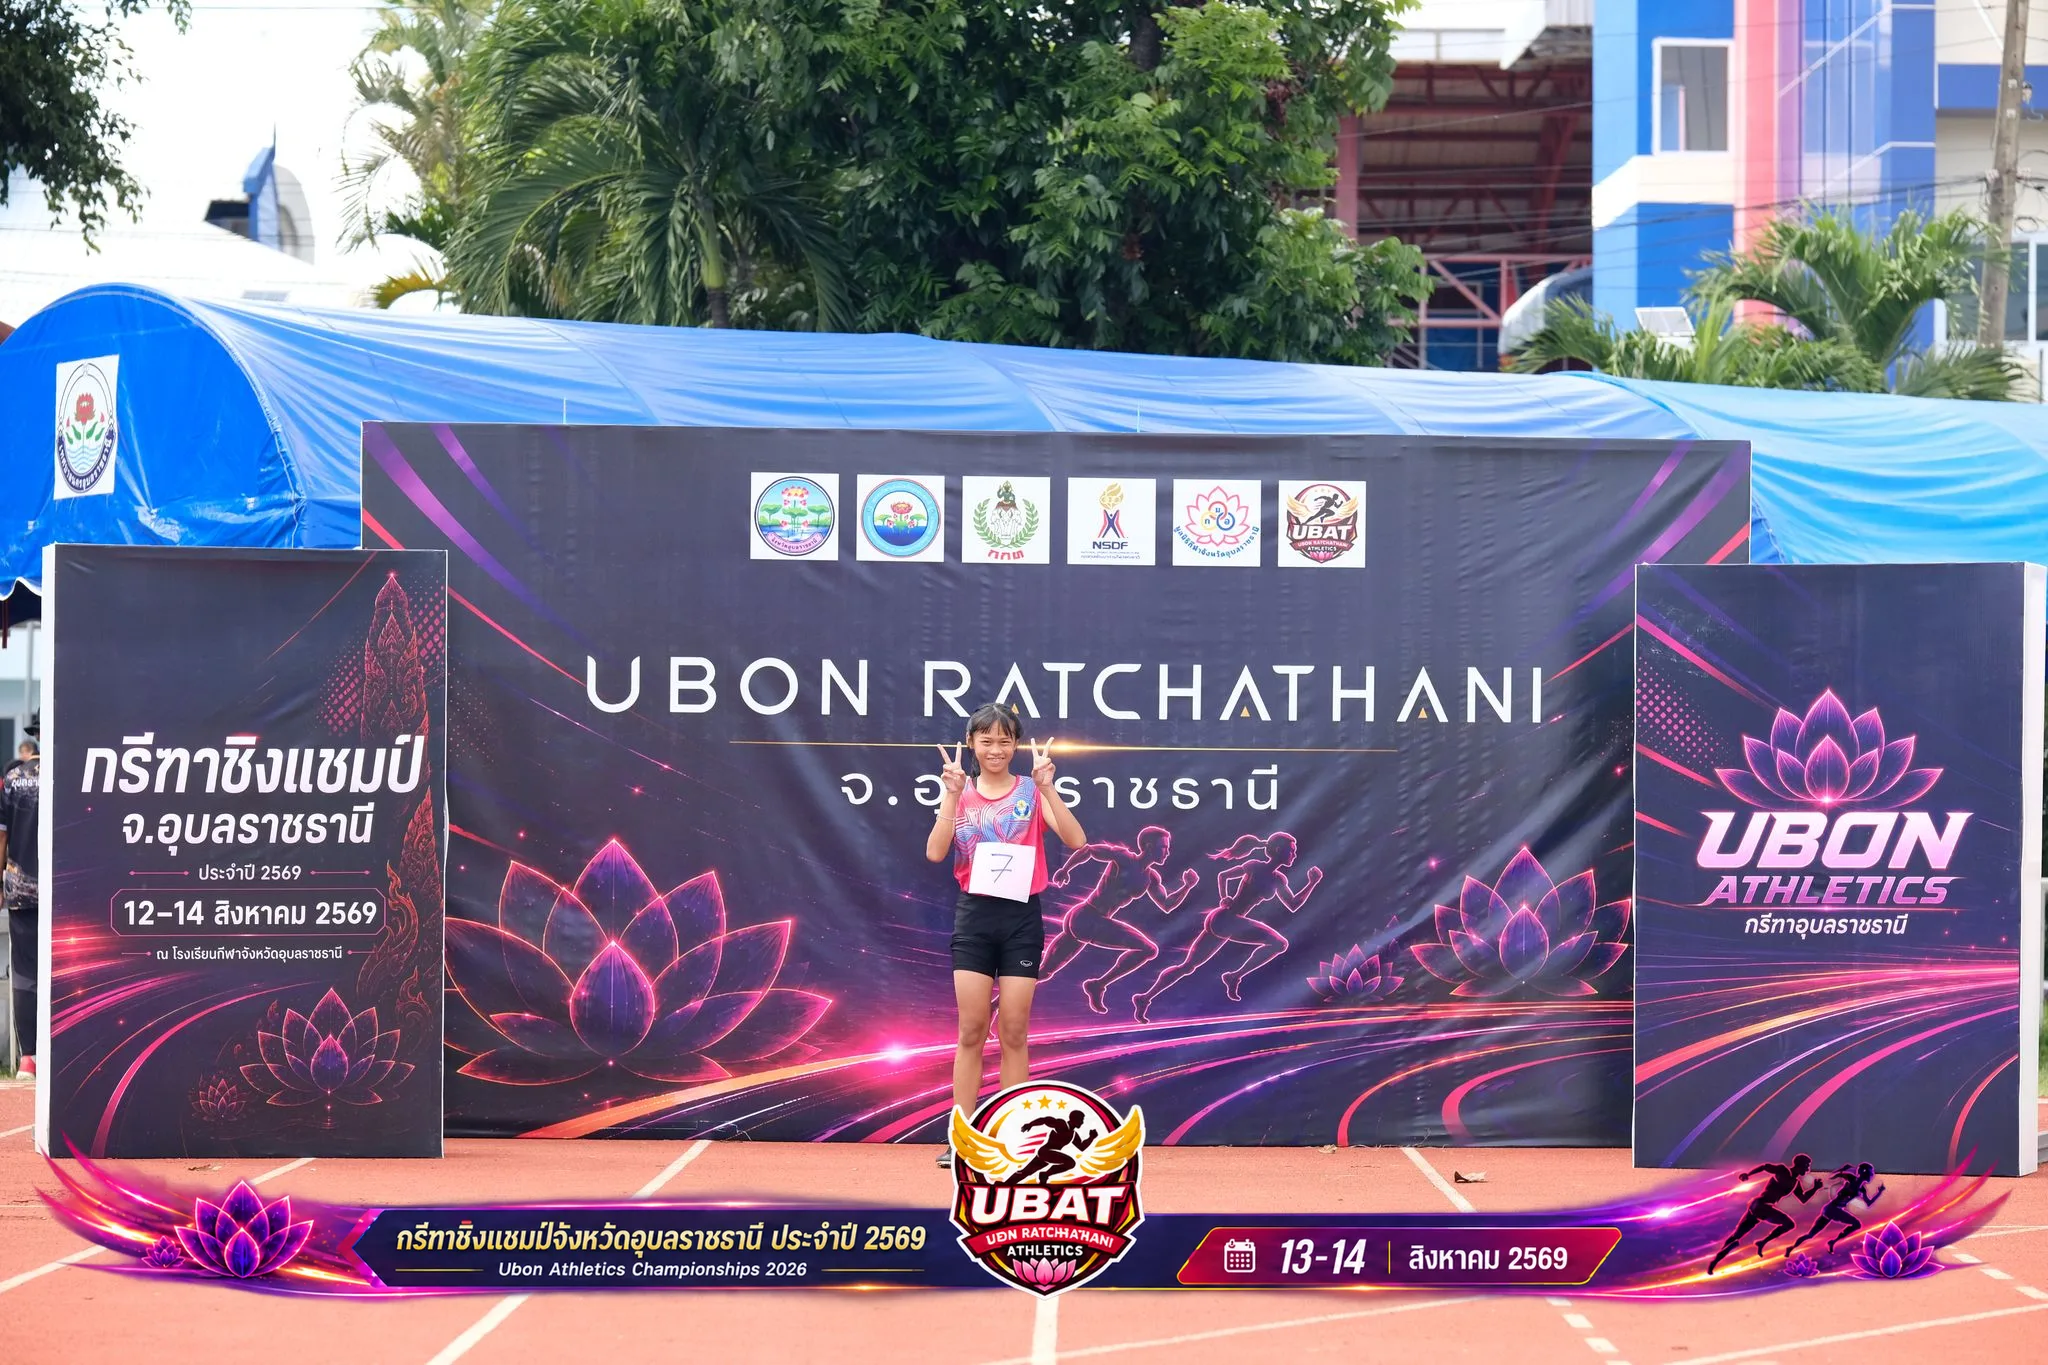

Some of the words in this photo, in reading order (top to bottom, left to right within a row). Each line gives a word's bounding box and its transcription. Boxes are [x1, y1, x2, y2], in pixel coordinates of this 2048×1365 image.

[1092, 541, 1129, 550] NSDF
[1292, 525, 1353, 540] UBAT
[987, 548, 1025, 561] กกท
[586, 655, 868, 716] UBON
[923, 660, 1543, 724] RATCHATHANI
[81, 732, 425, 794] กรีฑาชิงแชมป์
[122, 801, 375, 857] จ.อุบลราชธานี
[1696, 810, 1974, 870] UBON
[198, 863, 256, 881] ประจำปี
[260, 866, 302, 881] 2569
[991, 853, 1013, 883] 7
[1698, 874, 1964, 908] ATHLETICS
[214, 899, 306, 926] สิงหาคม
[315, 902, 377, 925] 2569
[1744, 912, 1909, 940] กรีฑาอุบลราชธานี
[156, 949, 169, 961] ณ
